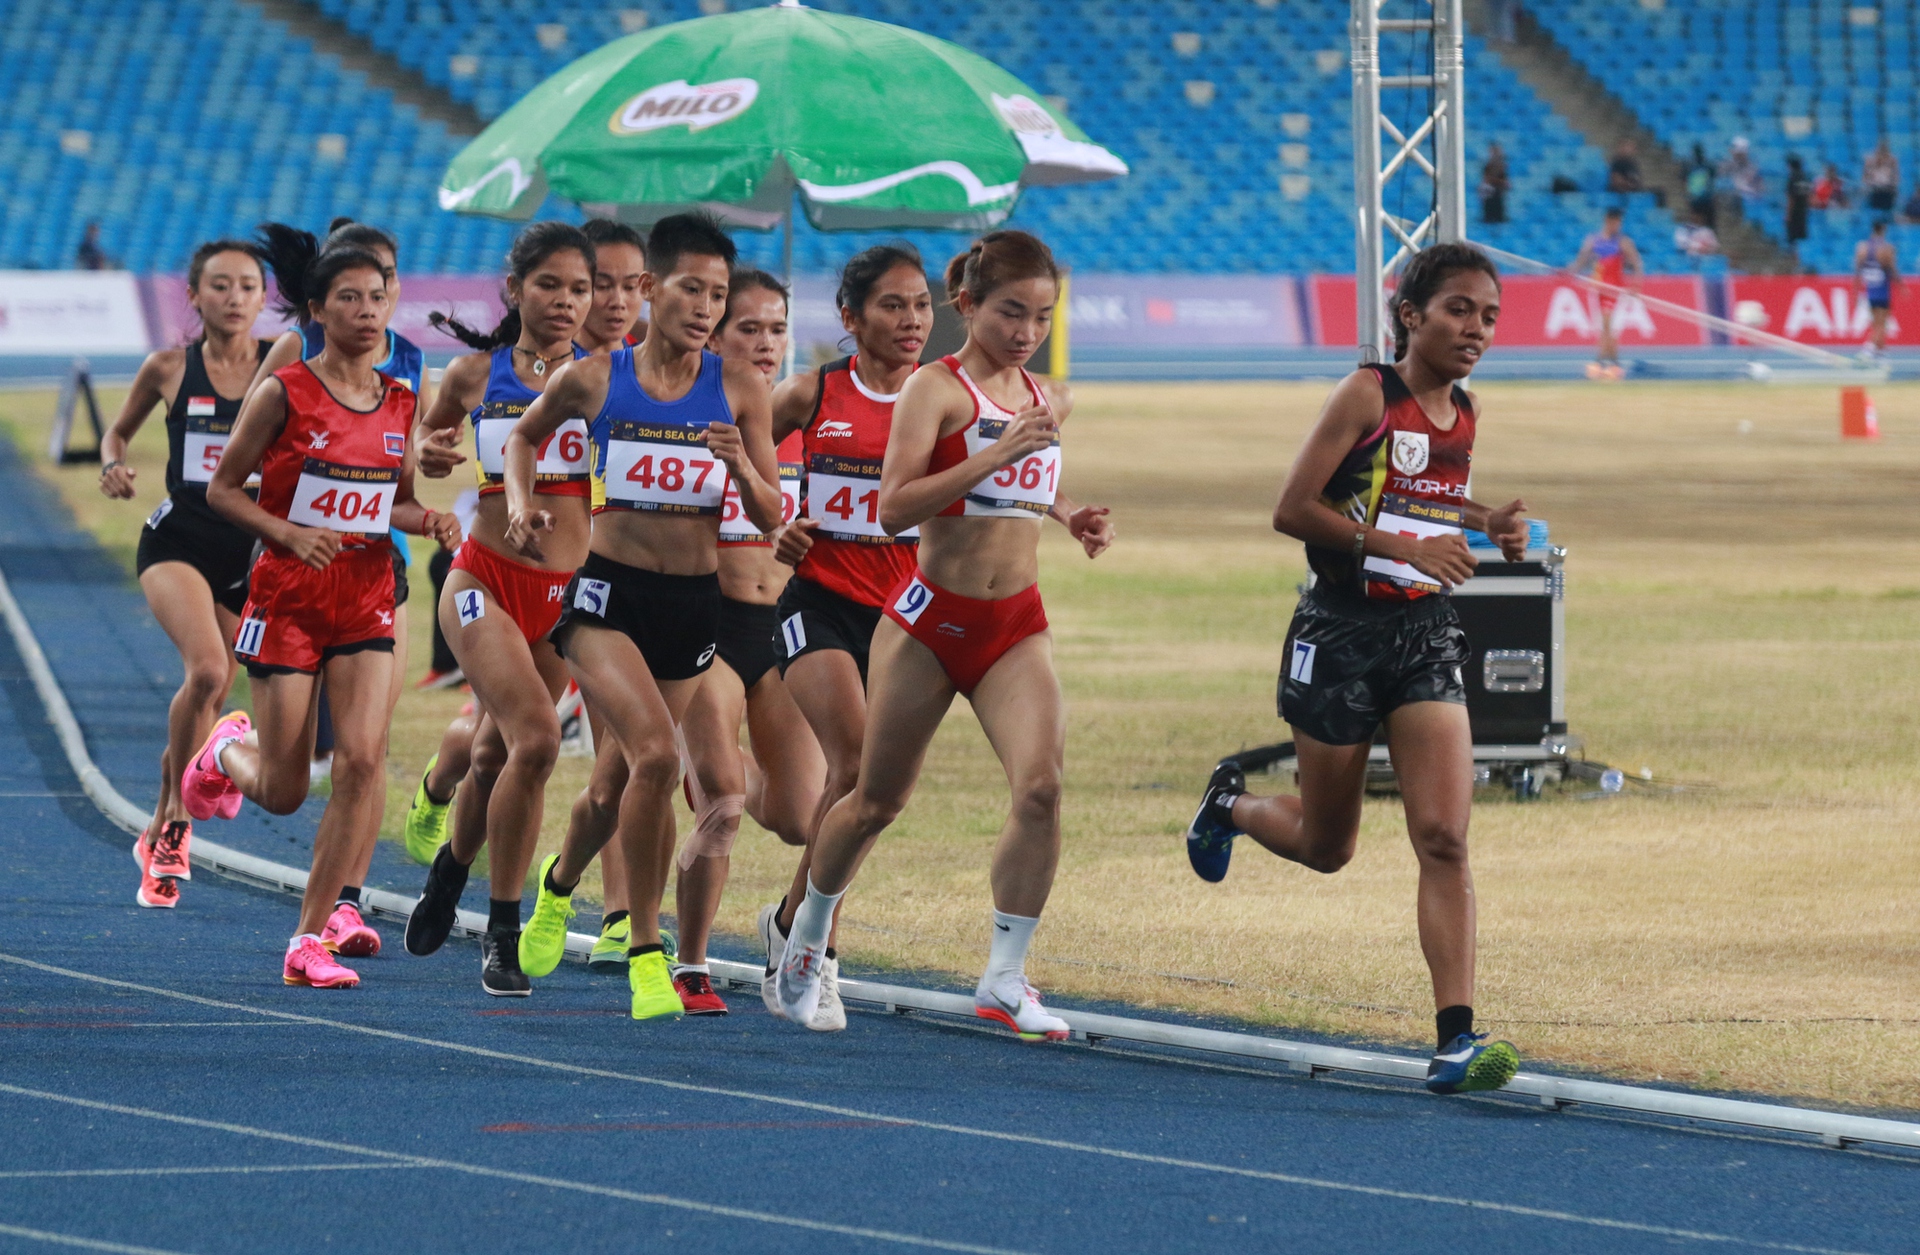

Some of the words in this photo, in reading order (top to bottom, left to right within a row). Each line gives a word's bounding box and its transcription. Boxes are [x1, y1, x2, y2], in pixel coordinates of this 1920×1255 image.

[632, 93, 741, 119] MILO
[638, 428, 662, 438] 32nd
[665, 430, 684, 440] SEA
[328, 467, 349, 478] 32nd
[350, 471, 365, 479] SEA
[366, 473, 392, 481] GAMES
[626, 454, 714, 494] 487
[778, 467, 798, 476] MES
[837, 463, 860, 473] 32nd
[861, 465, 882, 474] SEA
[993, 456, 1056, 493] 561
[310, 488, 382, 521] 404
[825, 486, 879, 524] 41
[1408, 504, 1429, 516] 32nd
[1429, 508, 1443, 519] SEA
[462, 590, 480, 619] 4
[581, 581, 606, 613] 5
[897, 584, 926, 614] 9
[238, 621, 261, 653] 11
[786, 618, 802, 654] 1
[1295, 642, 1312, 680] 7
